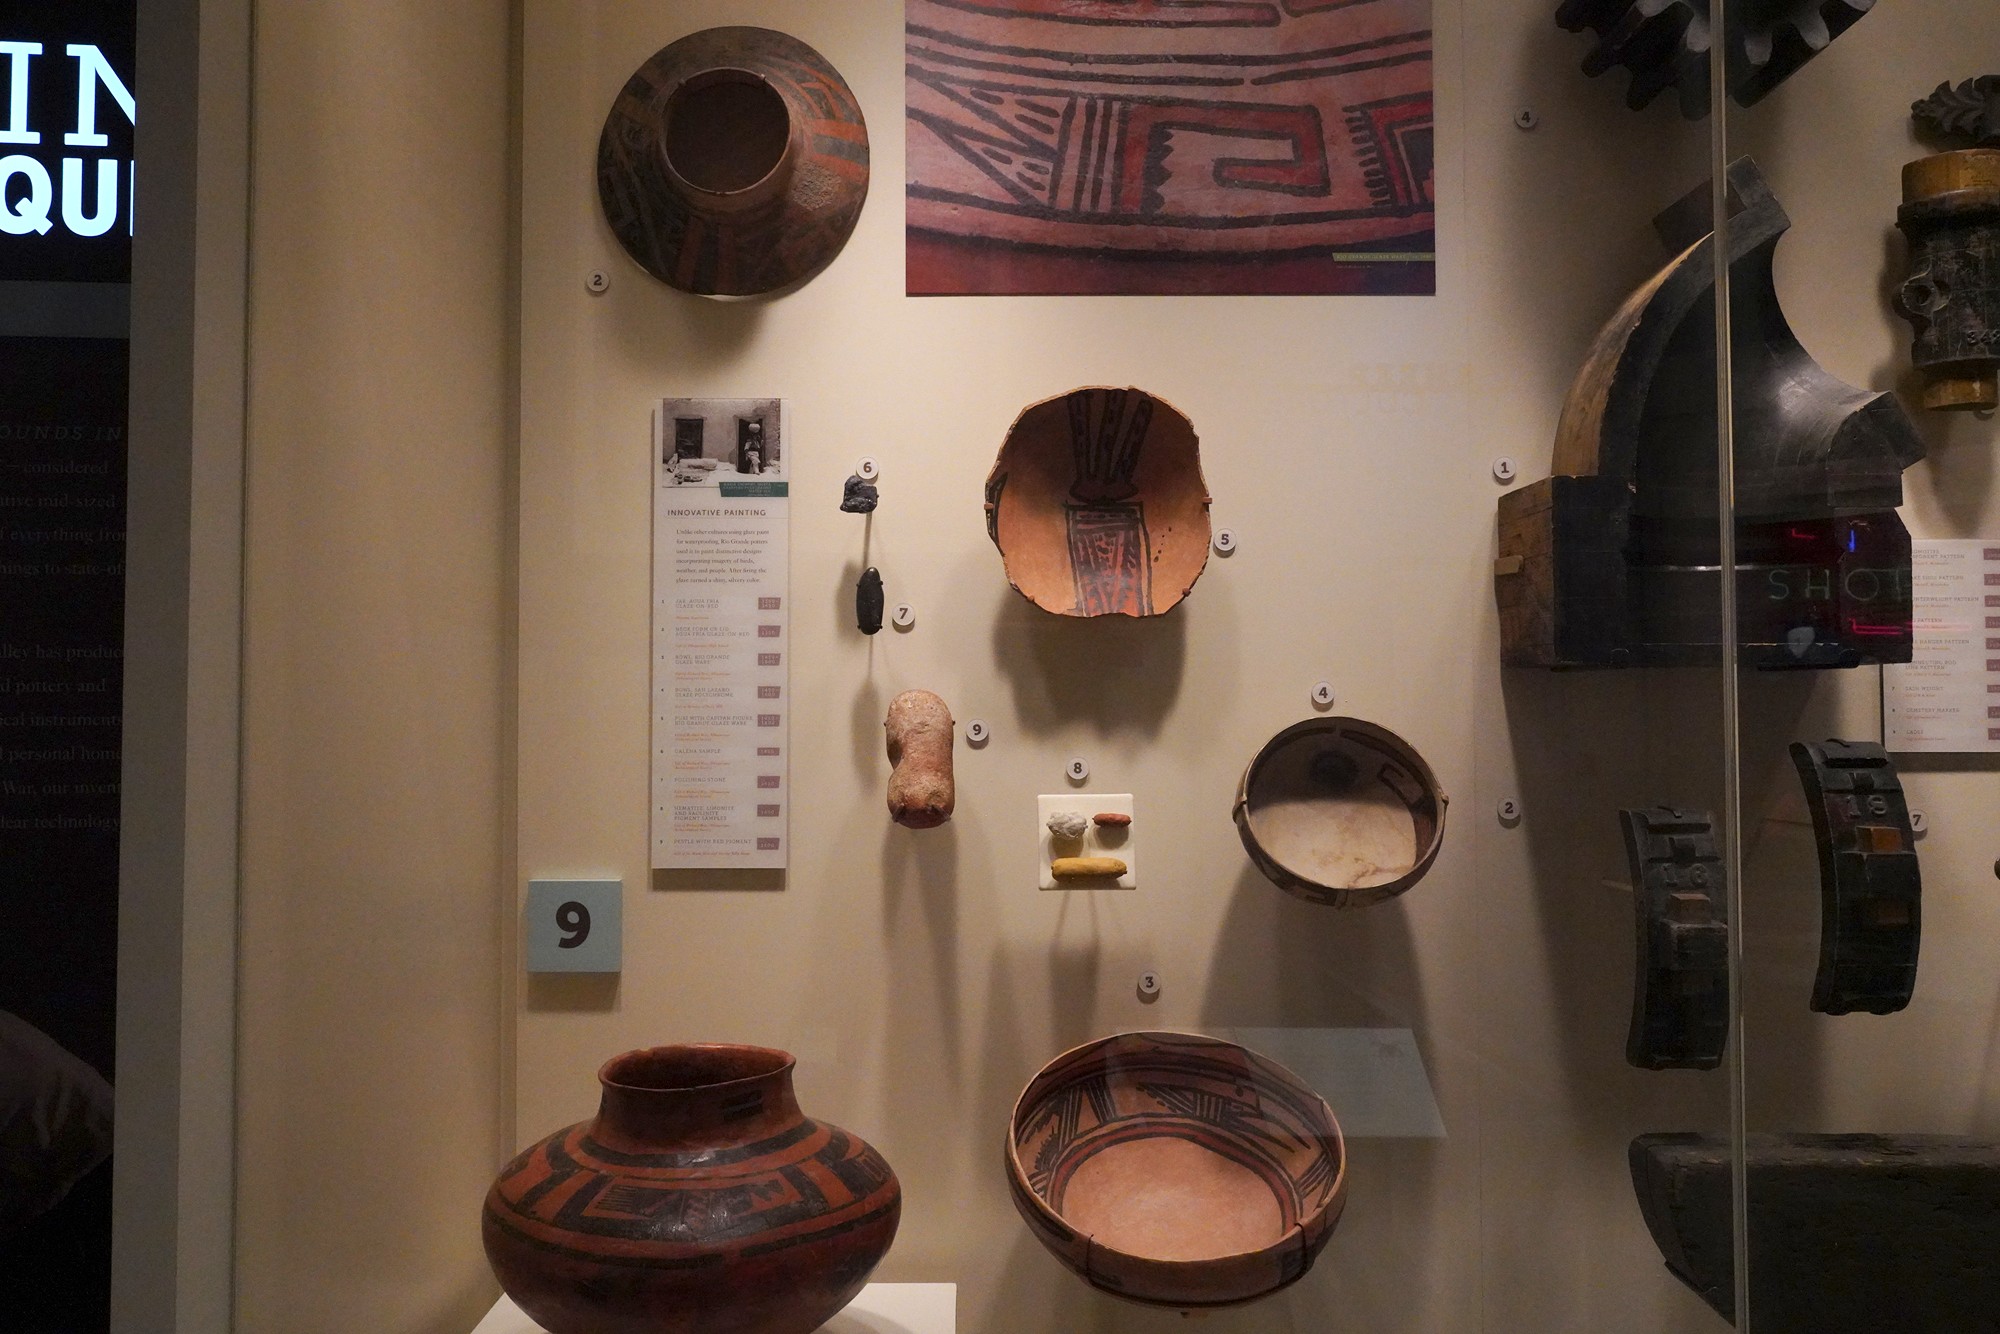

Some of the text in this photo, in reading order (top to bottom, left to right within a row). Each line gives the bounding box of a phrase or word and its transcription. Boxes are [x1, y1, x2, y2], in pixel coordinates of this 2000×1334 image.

[1521, 111, 1531, 123] 4
[0, 155, 135, 237] QU
[593, 274, 602, 286] 2
[24, 459, 109, 474] considered
[863, 461, 872, 473] 6
[1501, 461, 1509, 473] 1
[11, 527, 94, 544] everything
[1221, 534, 1229, 546] 5
[44, 562, 60, 578] to
[899, 607, 908, 619] 7
[36, 643, 61, 661] has
[15, 678, 72, 695] pottery
[77, 678, 107, 695] and
[1318, 687, 1328, 699] 4
[972, 724, 982, 735] 9
[9, 746, 76, 763] personal
[1073, 762, 1083, 774] 8
[42, 781, 68, 796] our
[1505, 802, 1514, 813] 2
[1912, 814, 1922, 826] 7
[556, 901, 591, 949] 9
[1145, 976, 1154, 988] 3
